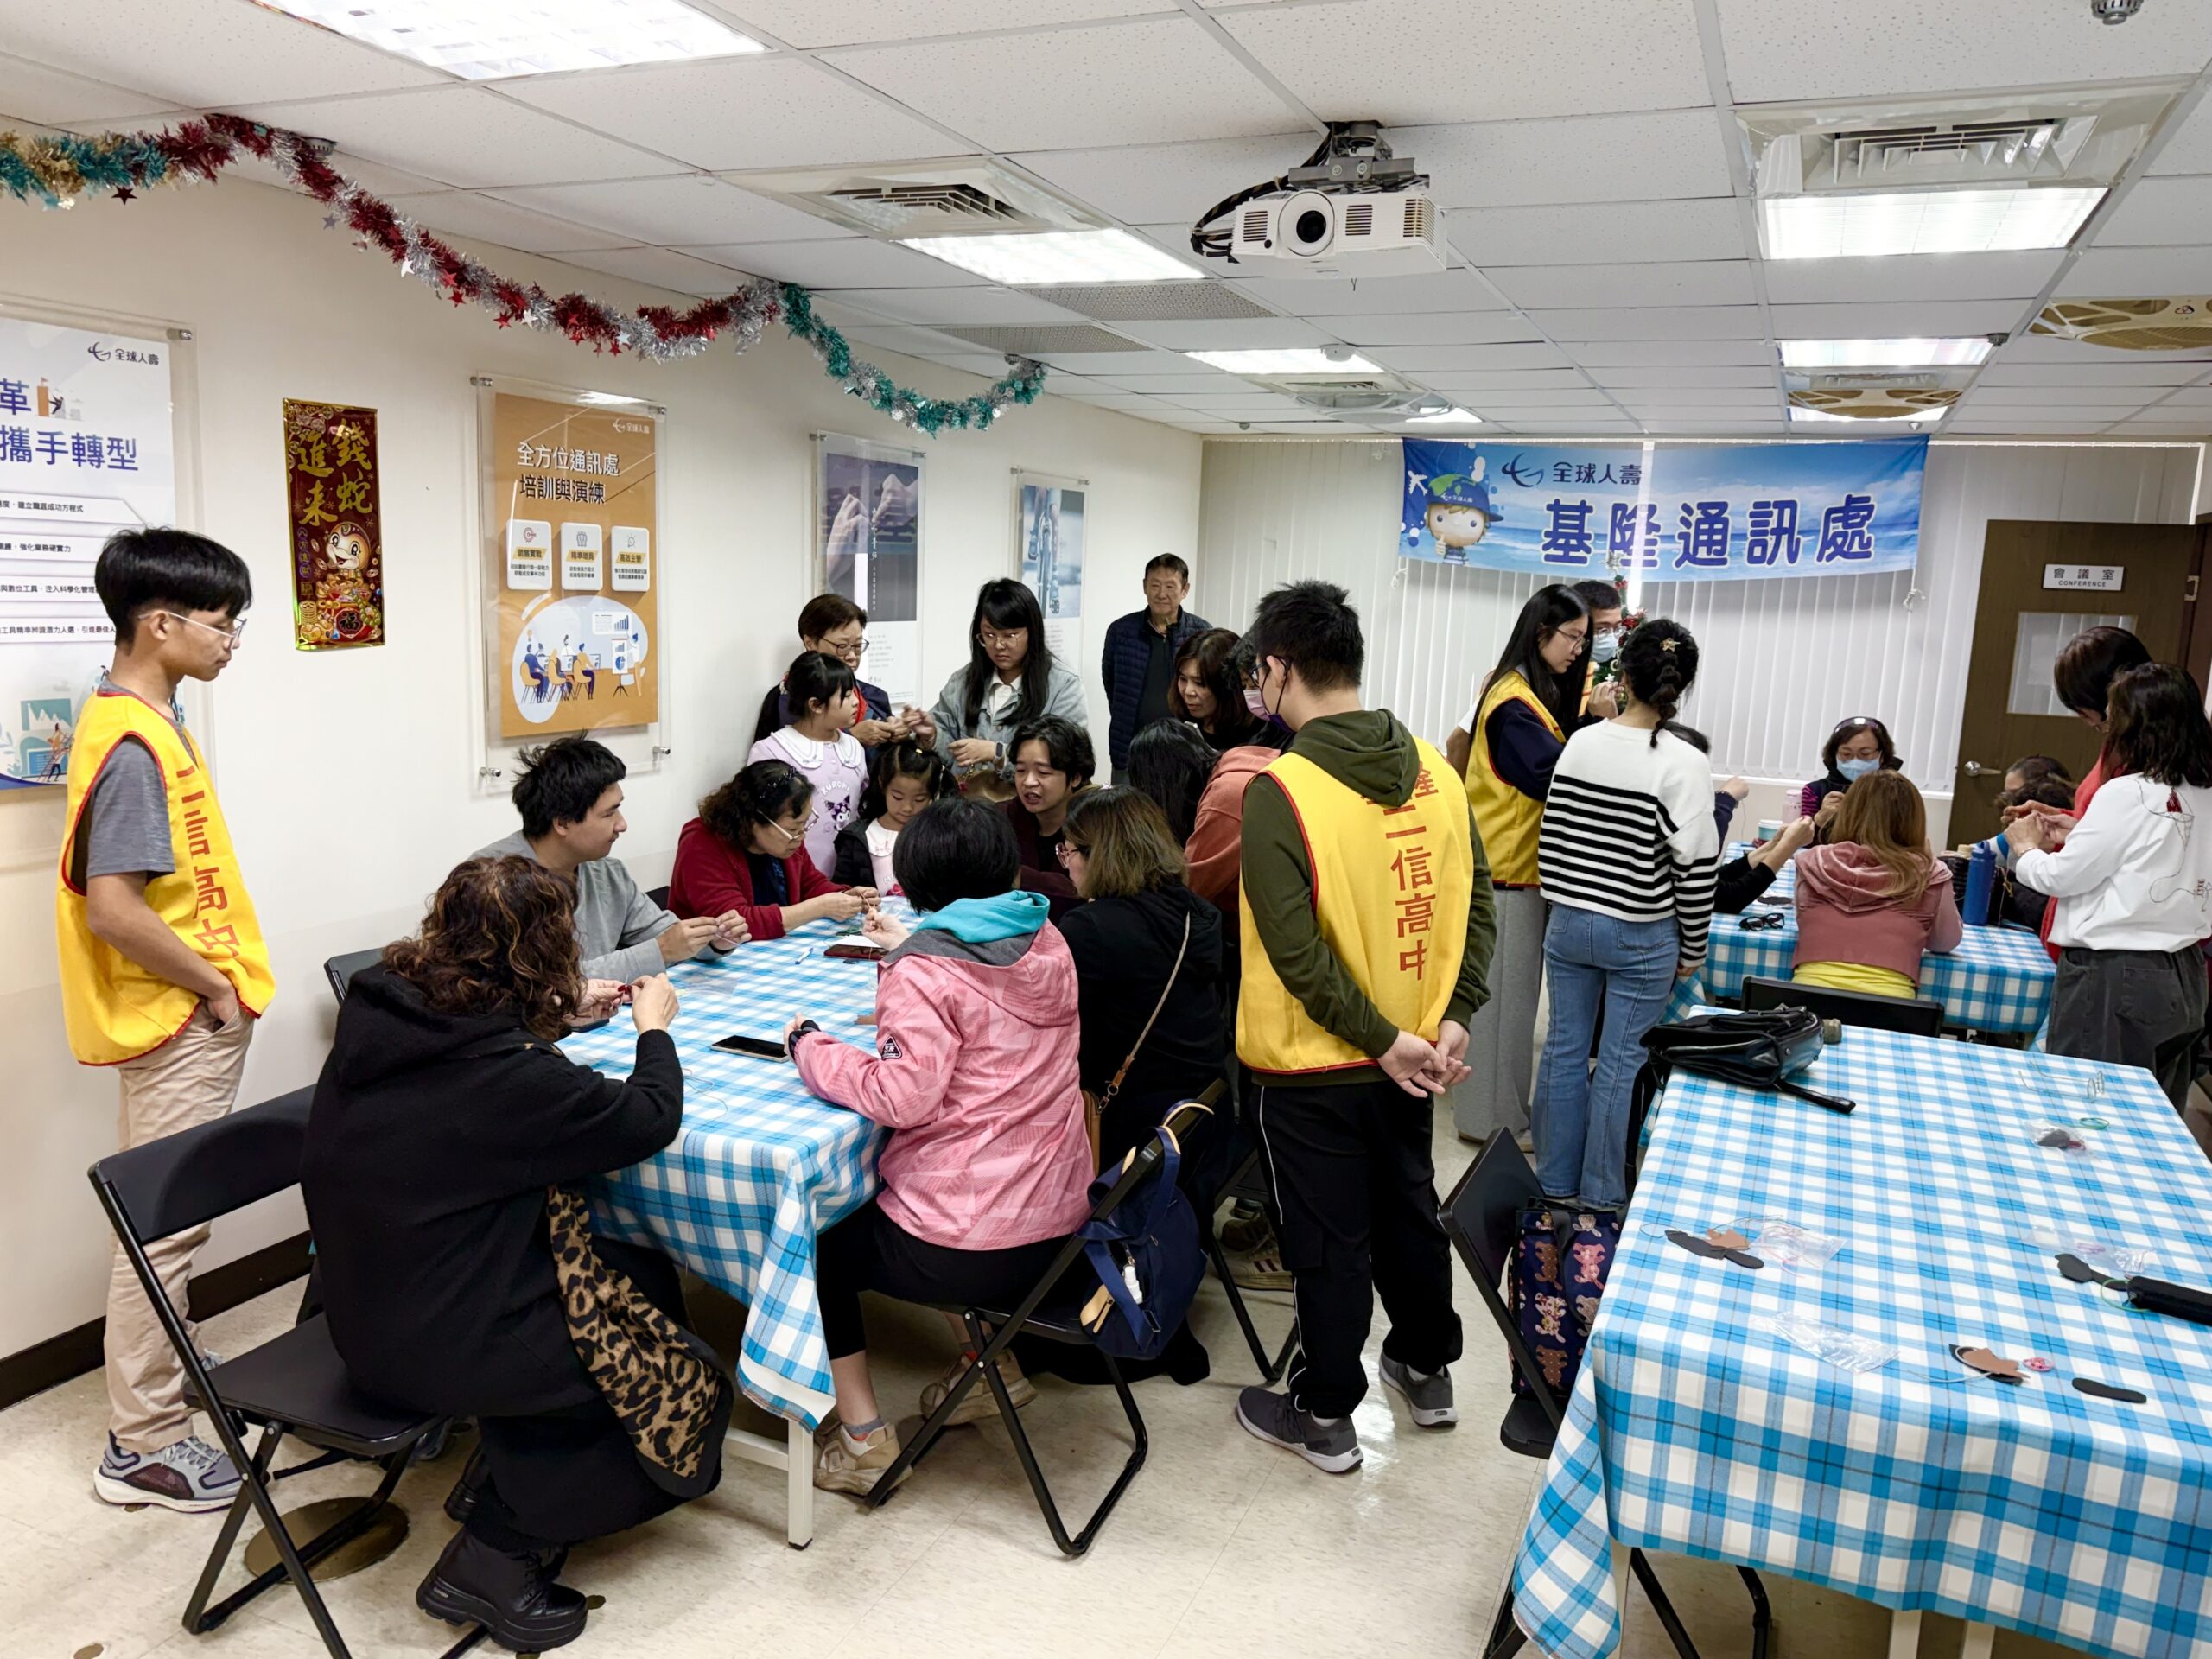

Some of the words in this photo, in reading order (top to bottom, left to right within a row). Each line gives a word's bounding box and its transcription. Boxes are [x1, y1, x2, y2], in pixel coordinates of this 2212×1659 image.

[114, 348, 159, 365] 全球人壽
[0, 378, 32, 415] 革
[0, 425, 138, 471] 攜手轉型
[517, 442, 620, 477] 全方位通訊處
[1553, 462, 1643, 485] 全球人壽
[519, 474, 607, 505] 培訓與演練
[1541, 493, 1877, 569] 基隆通訊處
[2054, 568, 2115, 581] 會議室
[820, 780, 851, 795] KUROMI
